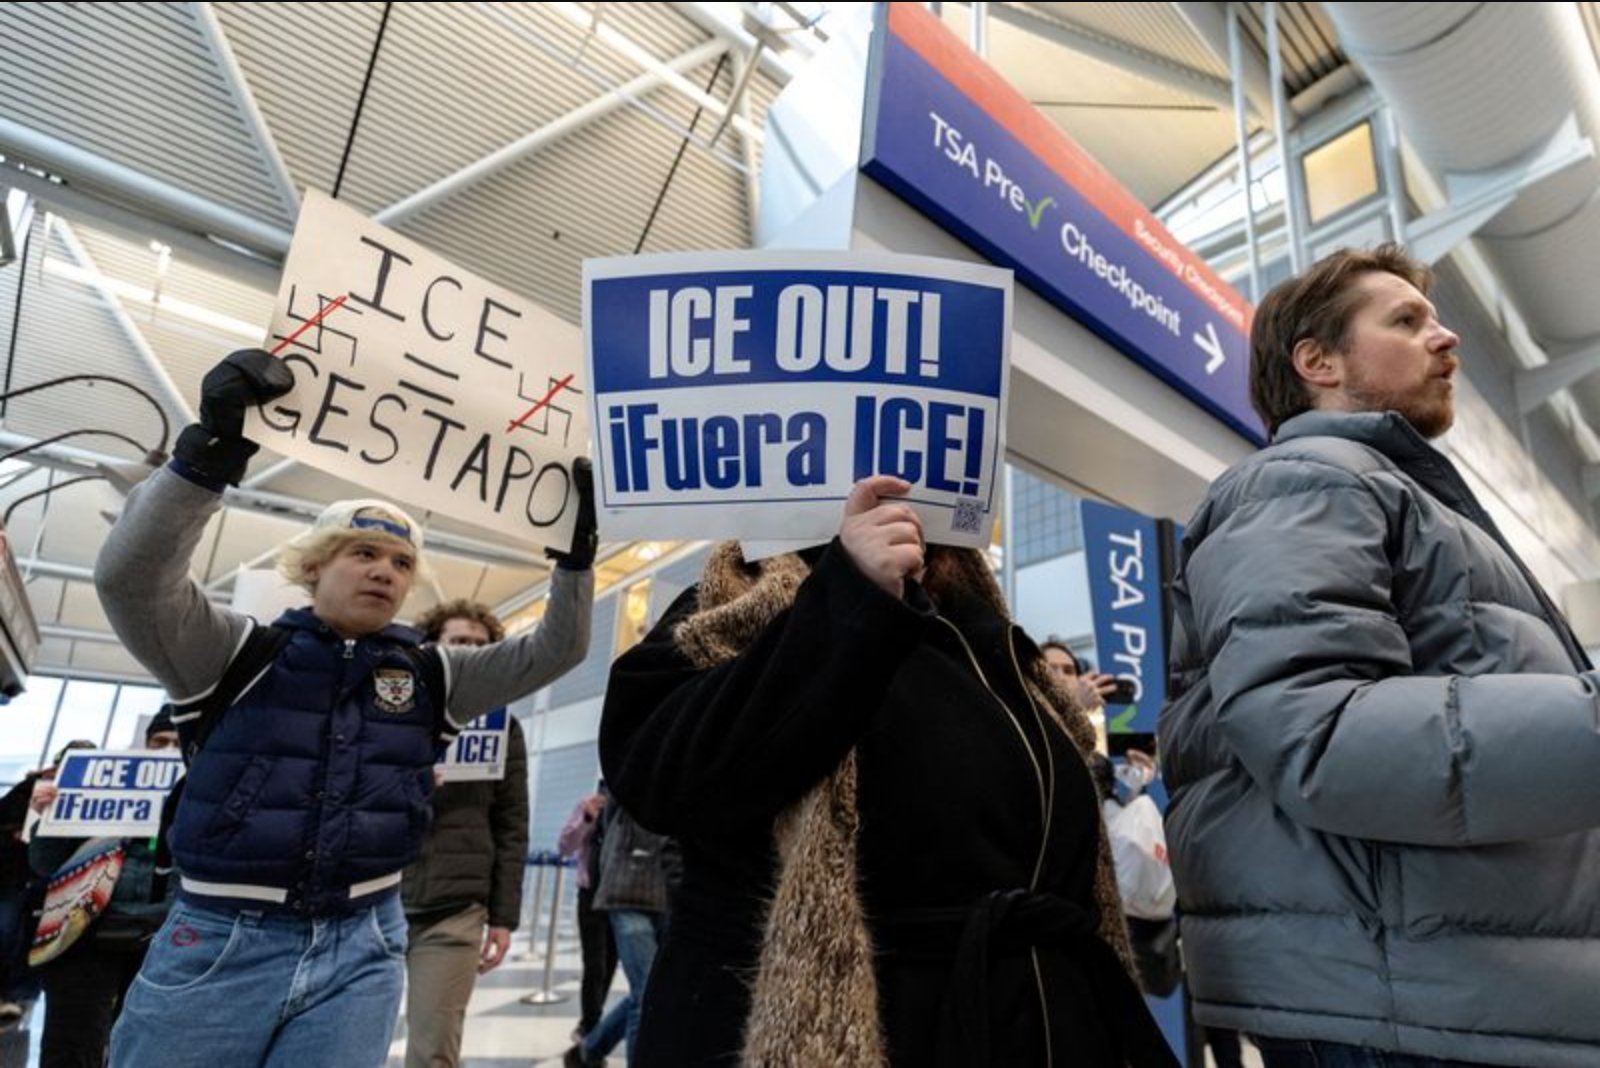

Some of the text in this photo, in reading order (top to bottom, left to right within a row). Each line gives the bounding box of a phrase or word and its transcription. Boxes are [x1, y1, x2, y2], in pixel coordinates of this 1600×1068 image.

[930, 111, 980, 179] TSA
[1060, 222, 1182, 337] Checkpoint
[348, 236, 522, 369] ICE
[648, 283, 942, 379] ICE OUT!
[258, 352, 571, 527] GESTAPO
[852, 395, 985, 496] ICE!
[1109, 529, 1145, 610] TSA
[81, 758, 130, 788] ICE
[455, 734, 500, 764] ICE!
